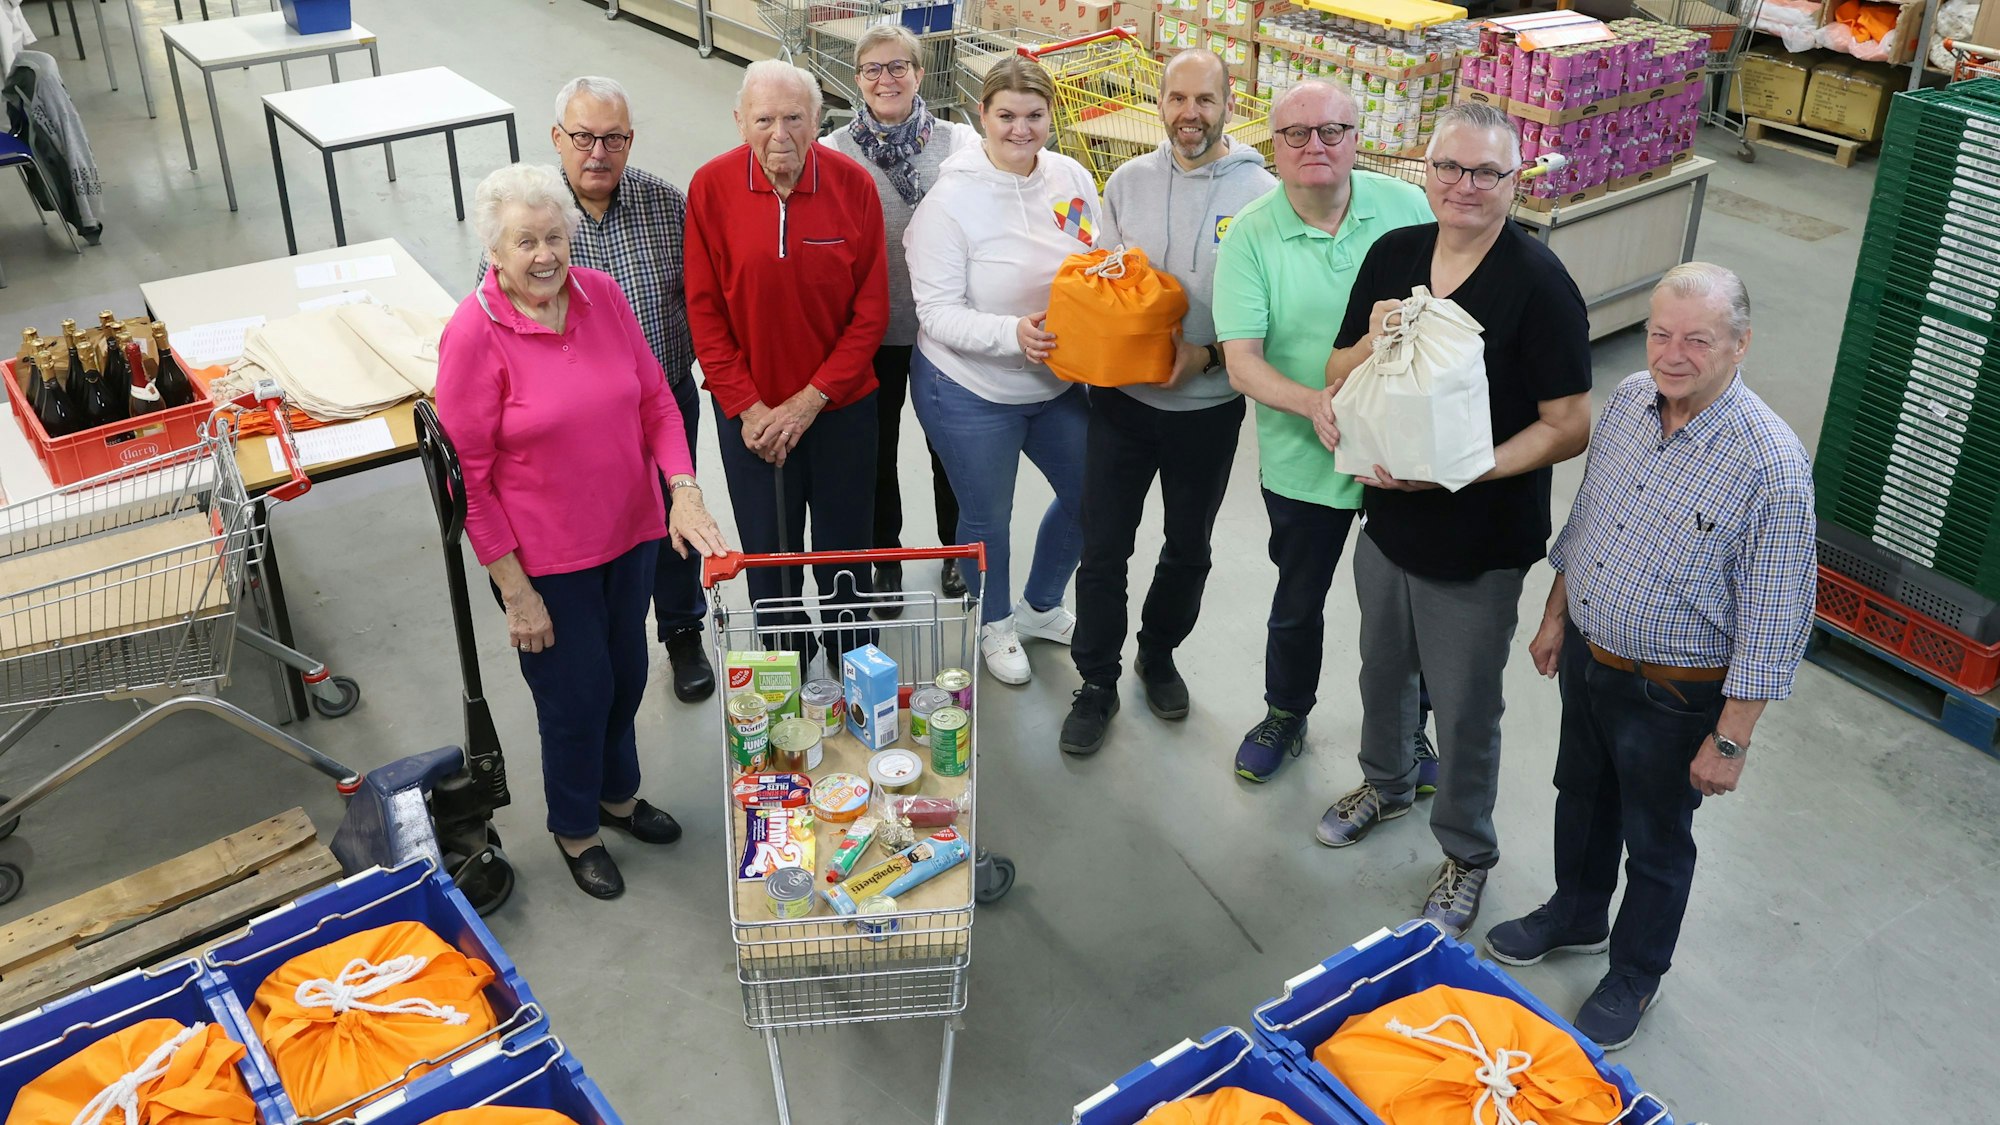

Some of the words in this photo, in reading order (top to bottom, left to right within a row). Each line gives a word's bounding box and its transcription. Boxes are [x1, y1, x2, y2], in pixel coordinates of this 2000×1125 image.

[122, 445, 156, 460] Harry
[759, 675, 792, 686] LANGKORN
[767, 782, 789, 791] FILETS
[851, 863, 902, 894] Spaghetti
